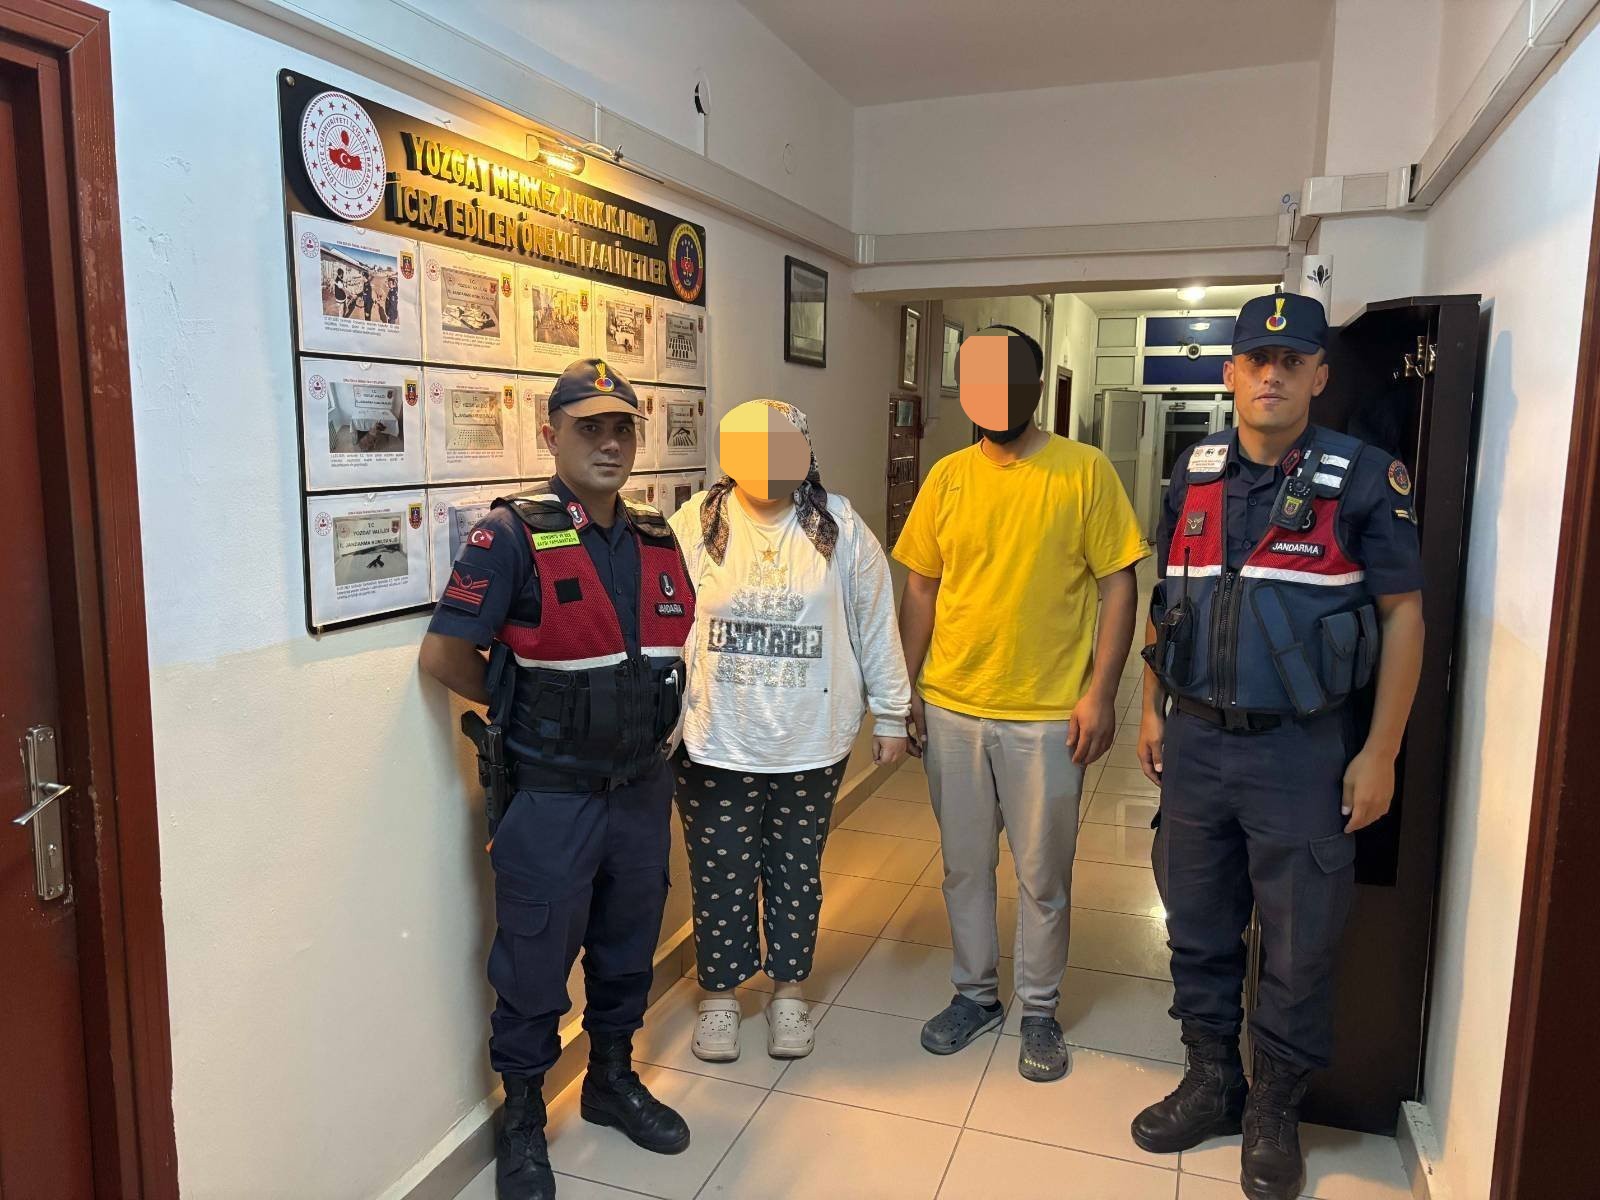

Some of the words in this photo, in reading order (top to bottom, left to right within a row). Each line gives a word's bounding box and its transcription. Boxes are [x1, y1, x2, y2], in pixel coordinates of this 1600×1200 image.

[409, 132, 491, 192] YOZGAT
[493, 163, 560, 213] MERKEZ
[395, 173, 447, 230] İCRA
[452, 199, 518, 250] EDİLEN
[521, 212, 581, 265] ÖNEMLİ
[581, 237, 667, 286] FAALİYETLER
[1272, 542, 1319, 555] JANDARMA
